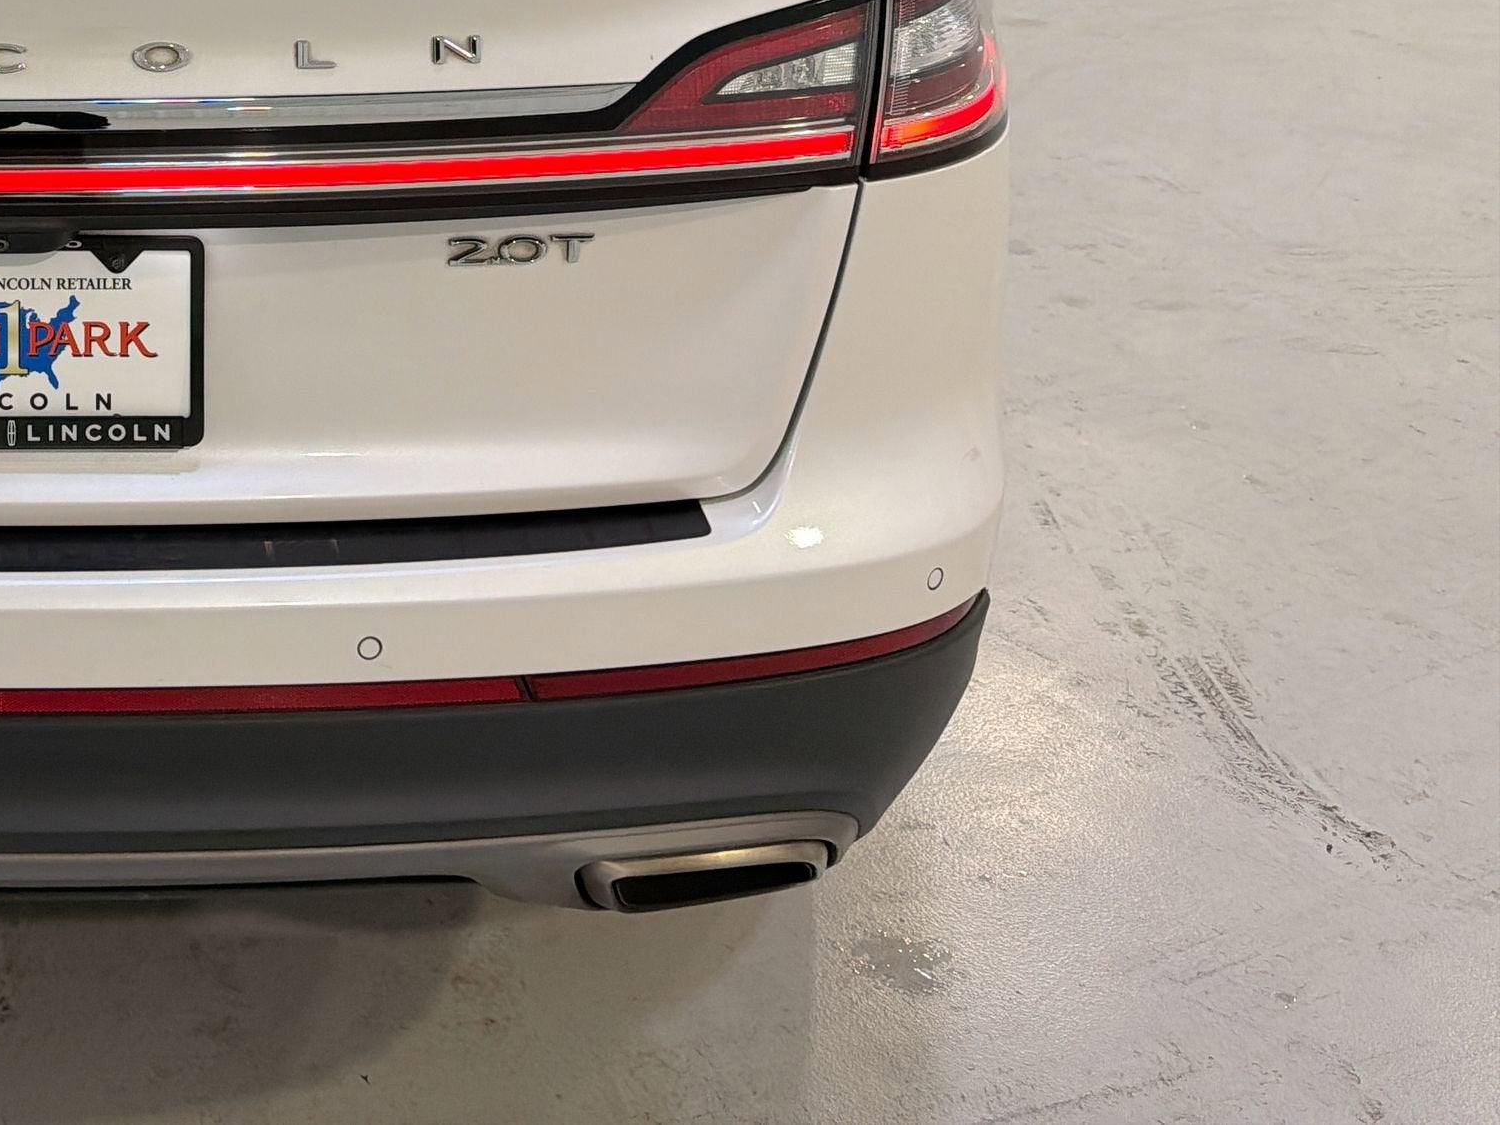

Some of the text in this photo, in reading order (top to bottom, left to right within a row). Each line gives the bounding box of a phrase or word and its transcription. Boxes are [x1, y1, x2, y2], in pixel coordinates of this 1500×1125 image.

[56, 277, 133, 291] RETAILER
[27, 320, 159, 359] PARK
[26, 423, 171, 442] LINCOLN
